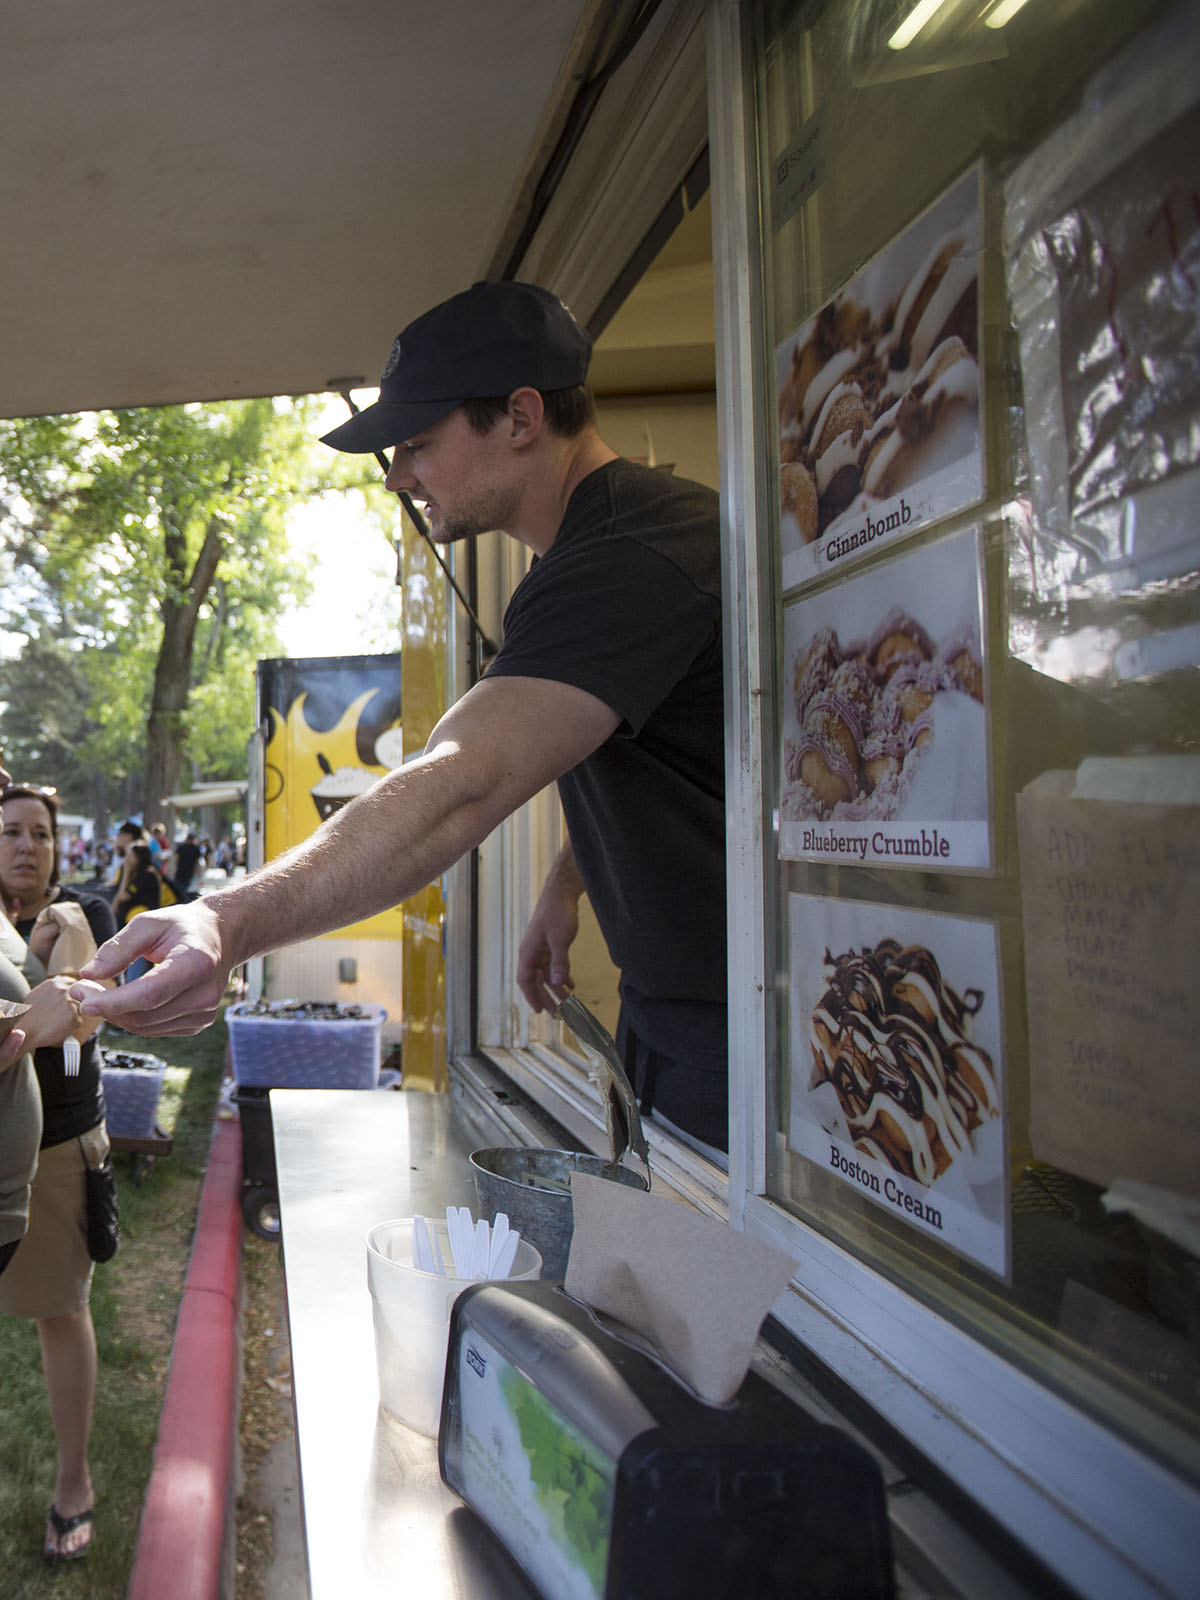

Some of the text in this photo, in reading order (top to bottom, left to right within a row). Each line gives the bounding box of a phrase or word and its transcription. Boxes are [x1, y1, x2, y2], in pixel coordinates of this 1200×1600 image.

[826, 498, 911, 562] Cinnabomb
[802, 828, 950, 860] Blueberry Crumble
[830, 1144, 943, 1230] Boston Cream
